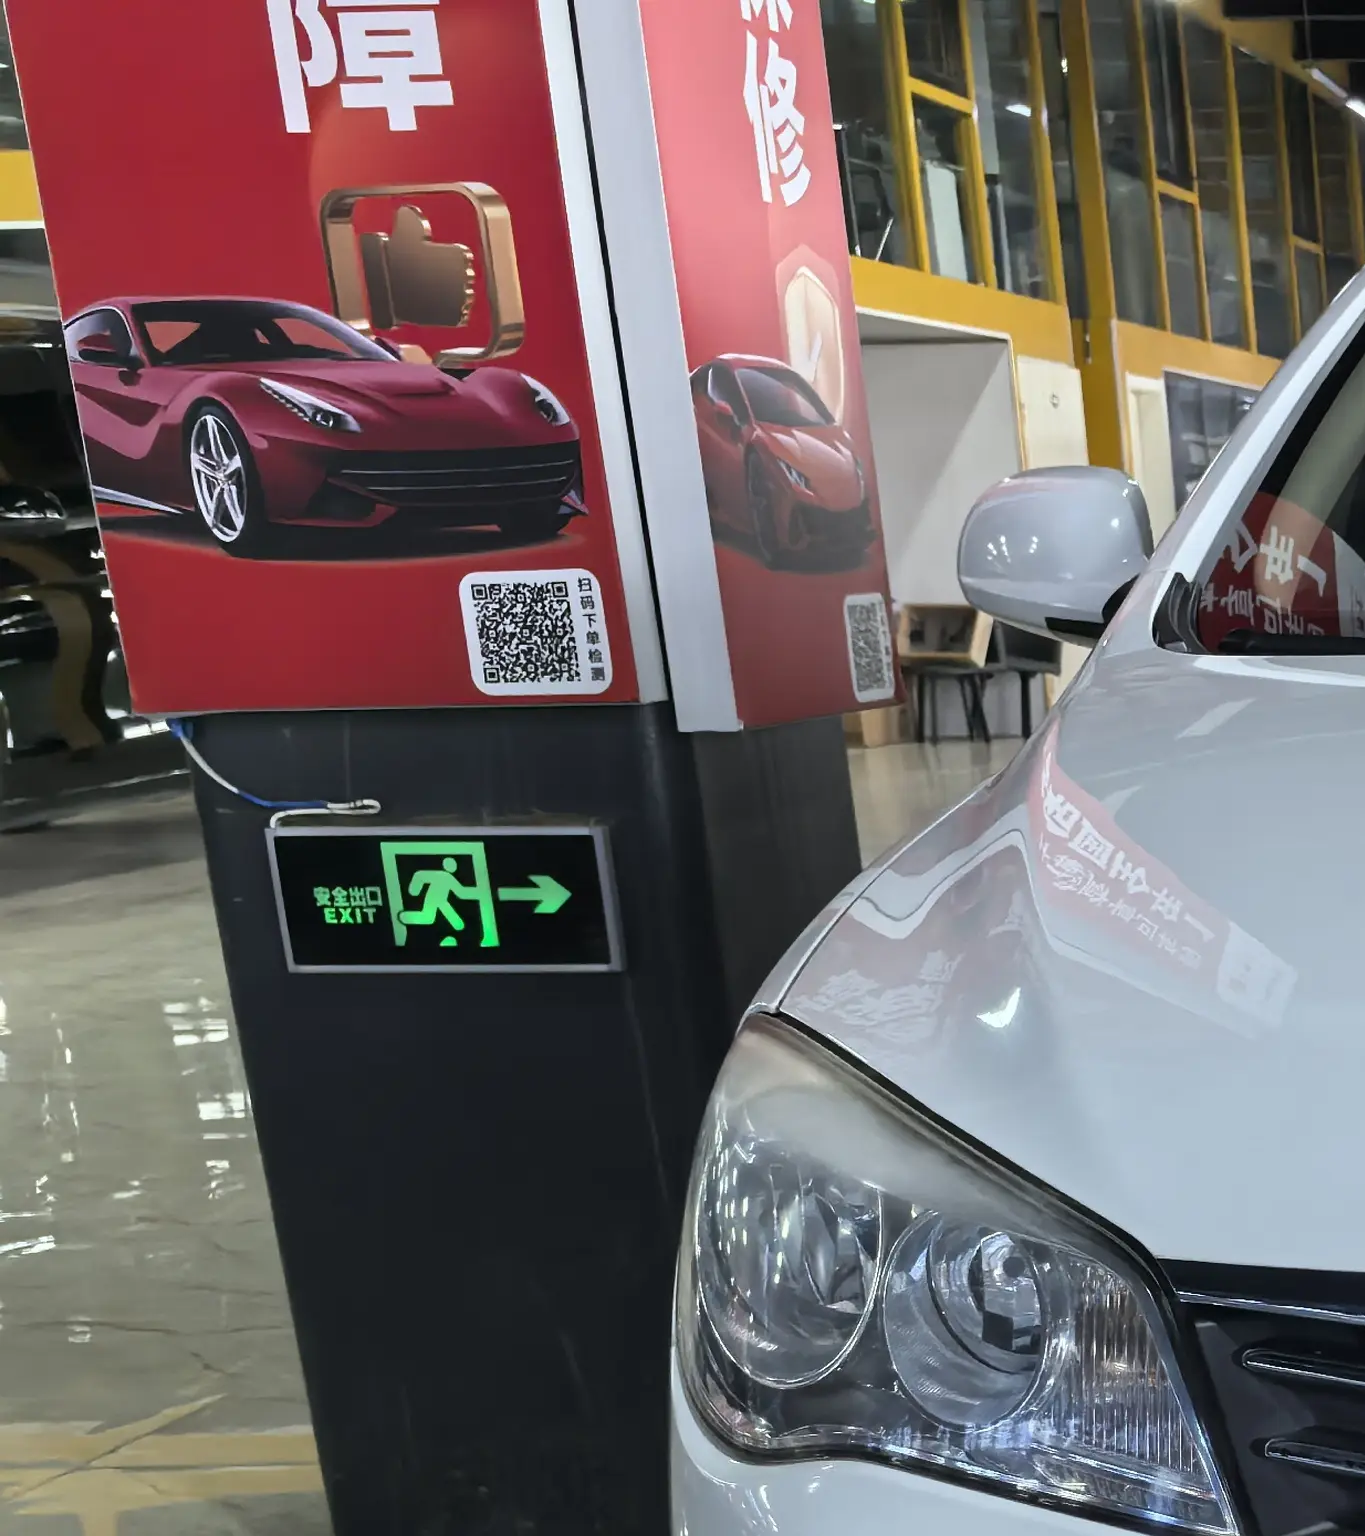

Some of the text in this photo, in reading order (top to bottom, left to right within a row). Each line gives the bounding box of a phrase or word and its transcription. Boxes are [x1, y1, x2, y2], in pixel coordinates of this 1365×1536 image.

[313, 886, 383, 907] 安全出口
[323, 907, 377, 924] EXIT
